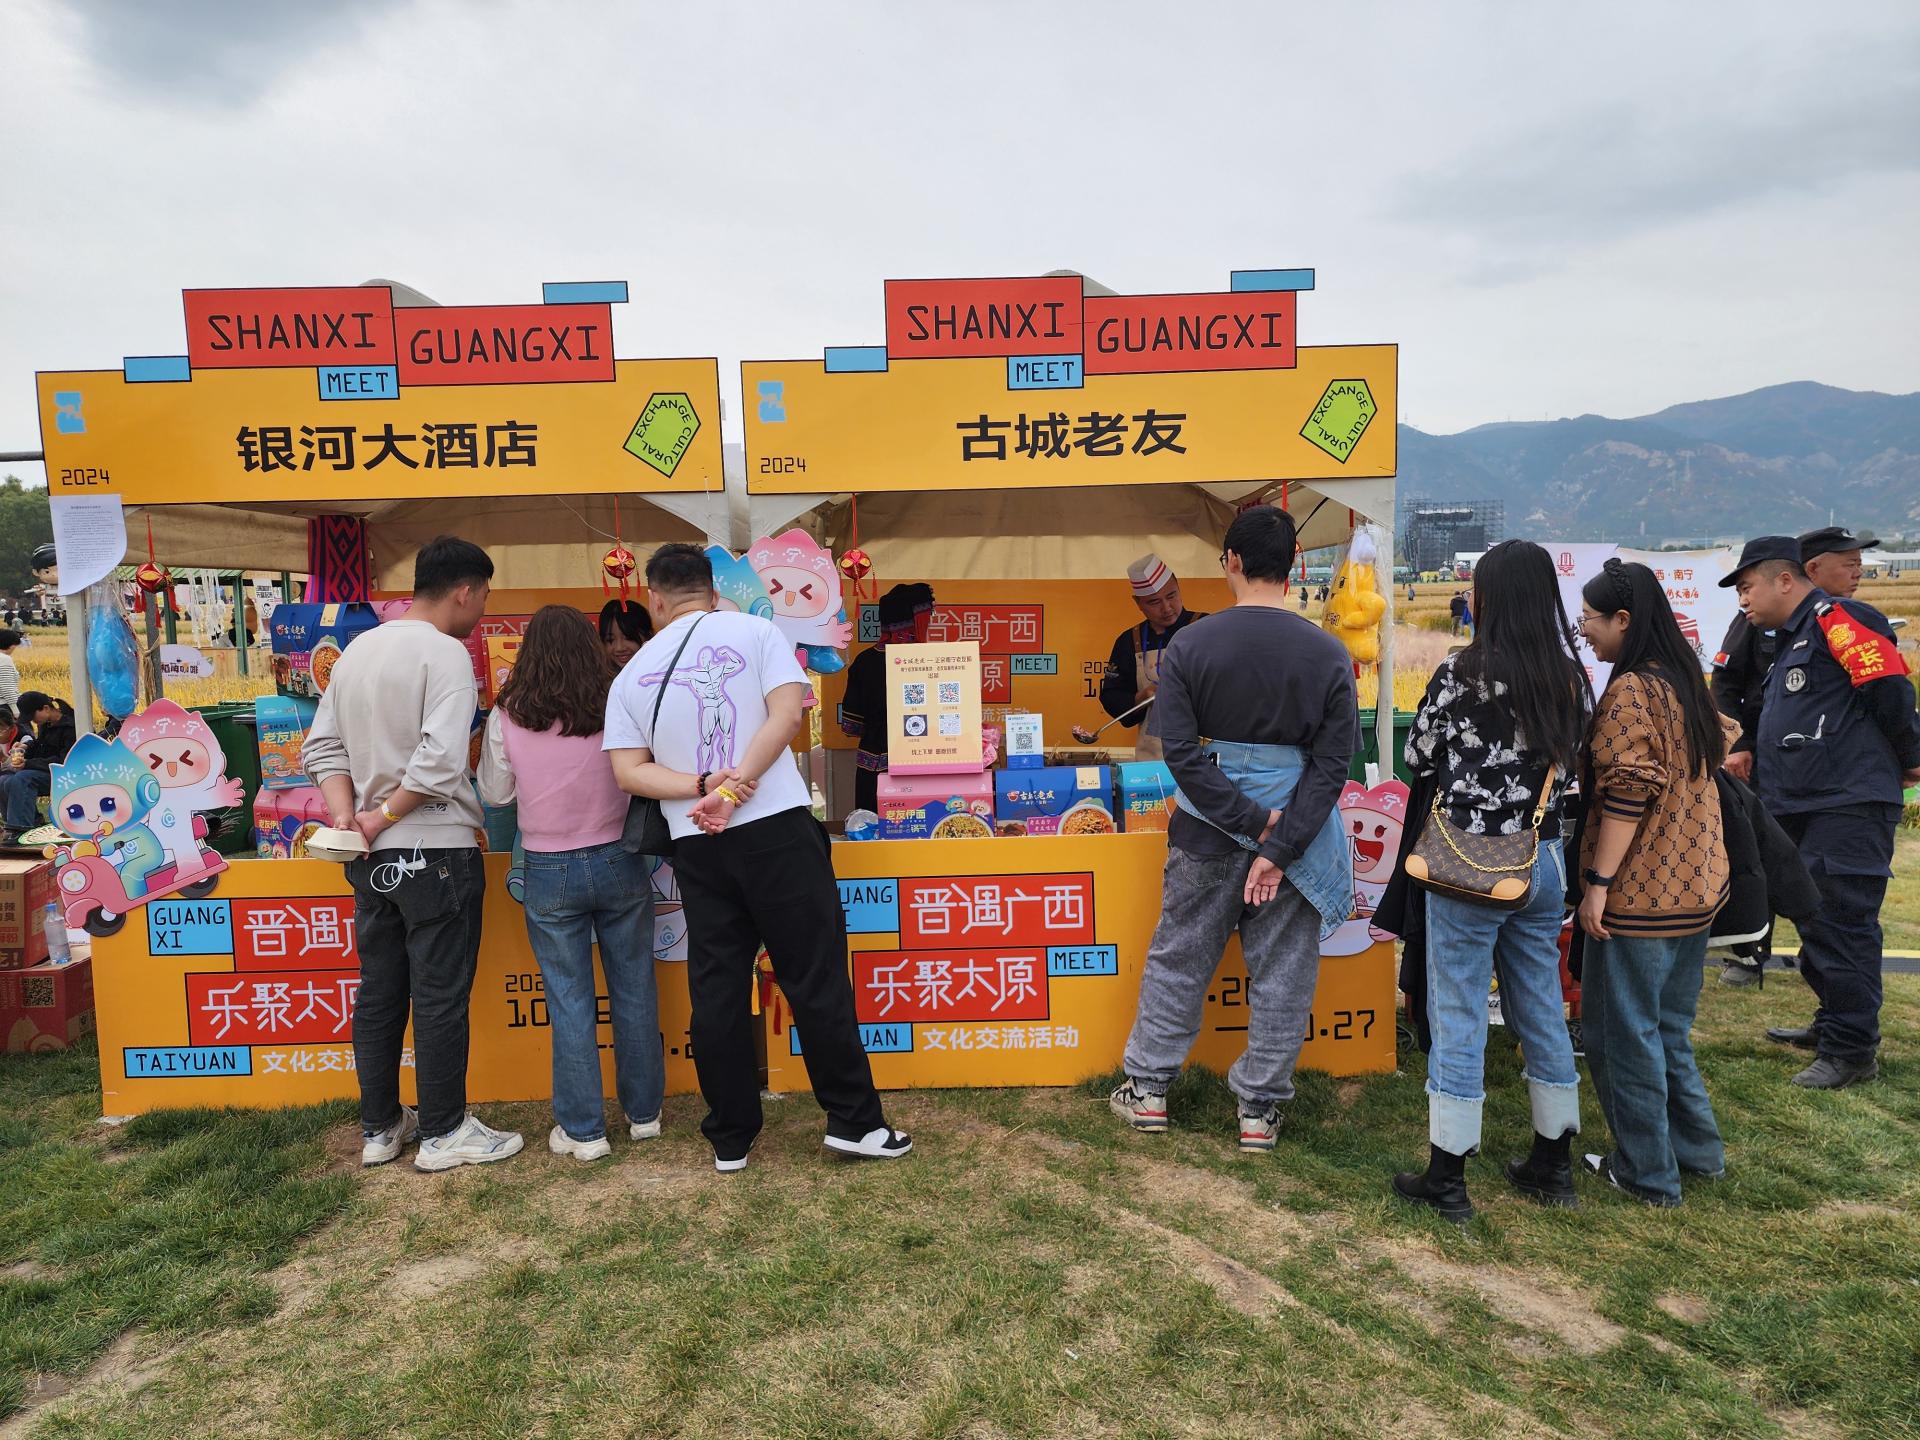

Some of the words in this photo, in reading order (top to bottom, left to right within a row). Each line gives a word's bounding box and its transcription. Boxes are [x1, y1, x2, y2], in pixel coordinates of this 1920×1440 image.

[209, 313, 377, 350] SHANXI
[907, 302, 1066, 341] SHANXI
[1097, 312, 1282, 353] GUANGXI
[410, 325, 600, 365] GUANGXI
[328, 372, 389, 393] MEET
[1016, 361, 1075, 383] MEET
[635, 400, 692, 439] EXCHANGE
[1312, 386, 1368, 424] EXCHANGE
[236, 421, 539, 472] 银河大酒店
[641, 427, 692, 465] CULTURAL
[957, 409, 1187, 462] 古城老友
[1318, 413, 1368, 451] CULTURAL
[62, 468, 110, 486] 2024
[760, 457, 806, 474] 2024
[862, 609, 880, 623] GU
[926, 609, 1036, 647] 晋遇广西
[981, 661, 1004, 692] 原
[1015, 658, 1052, 671] MEET
[838, 885, 893, 905] UANG
[910, 883, 1084, 935] 晋遇广西
[153, 906, 226, 926] GUANG
[243, 904, 356, 957] 晋遇
[156, 930, 184, 949] XI
[1054, 951, 1109, 970] MEET
[505, 973, 544, 993] 202
[866, 956, 1037, 1017] 乐聚太原
[922, 1026, 1080, 1051] 文化交流活动
[1305, 1010, 1375, 1041] .27
[135, 1052, 236, 1073] TAIYUAN
